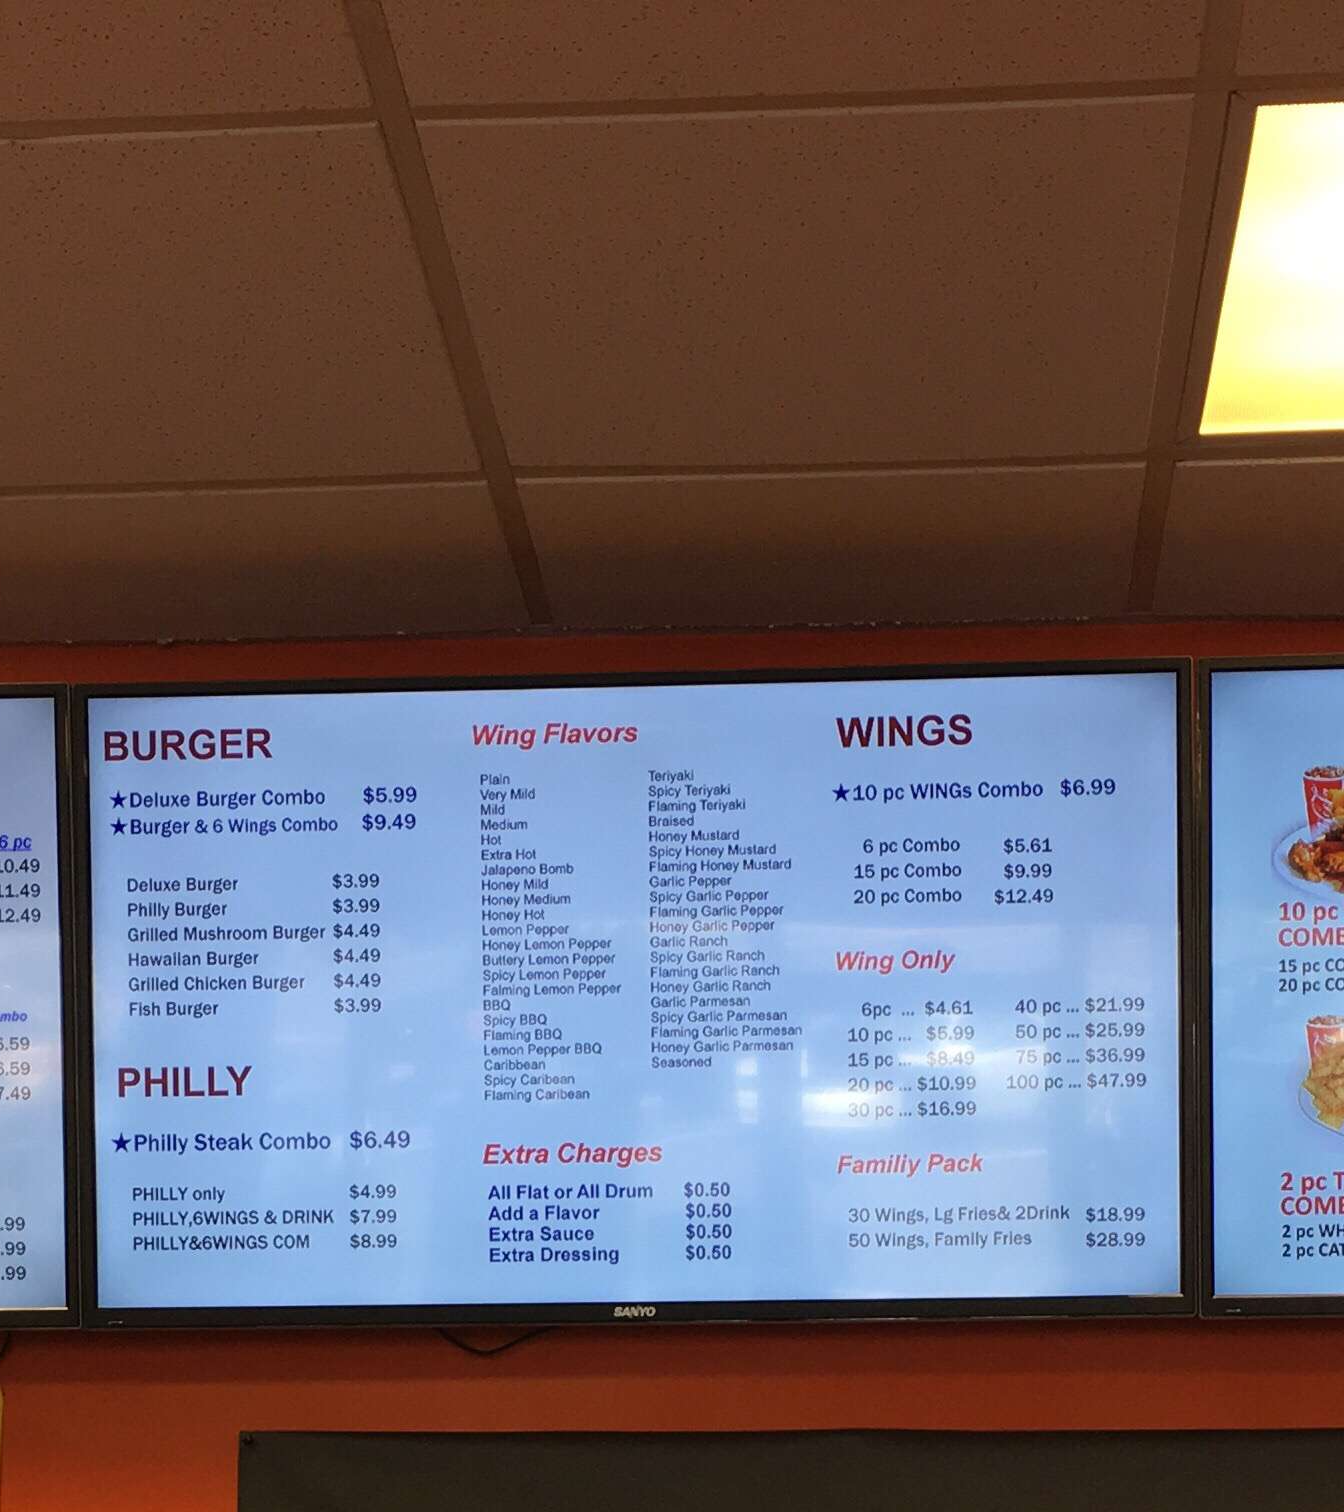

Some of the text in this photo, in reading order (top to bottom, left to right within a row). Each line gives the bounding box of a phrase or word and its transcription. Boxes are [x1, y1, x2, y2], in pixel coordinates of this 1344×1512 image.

[473, 723, 637, 750] Wing Flavors
[836, 714, 972, 748] WINGS
[104, 729, 272, 761] BURGER
[648, 770, 694, 784] Teriyaki
[130, 786, 417, 809] Deluxe Burger Combo $5.99
[853, 785, 877, 801] 10
[884, 787, 904, 803] pc
[978, 781, 1043, 798] Combo
[1061, 779, 1115, 797] $6.99
[649, 815, 694, 827] Braised
[1280, 902, 1305, 920] 10
[1314, 906, 1338, 925] pc
[837, 950, 955, 974] Wing Only
[119, 1066, 251, 1097] PHILLY
[483, 1143, 661, 1168] Extra Charges
[927, 1153, 983, 1173] Pack
[1281, 1172, 1293, 1191] 2
[1302, 1176, 1327, 1195] pc
[264, 1210, 277, 1224] &
[283, 1210, 333, 1224] DRINK
[350, 1209, 396, 1224] $7.99
[614, 1306, 656, 1318] SANYO
